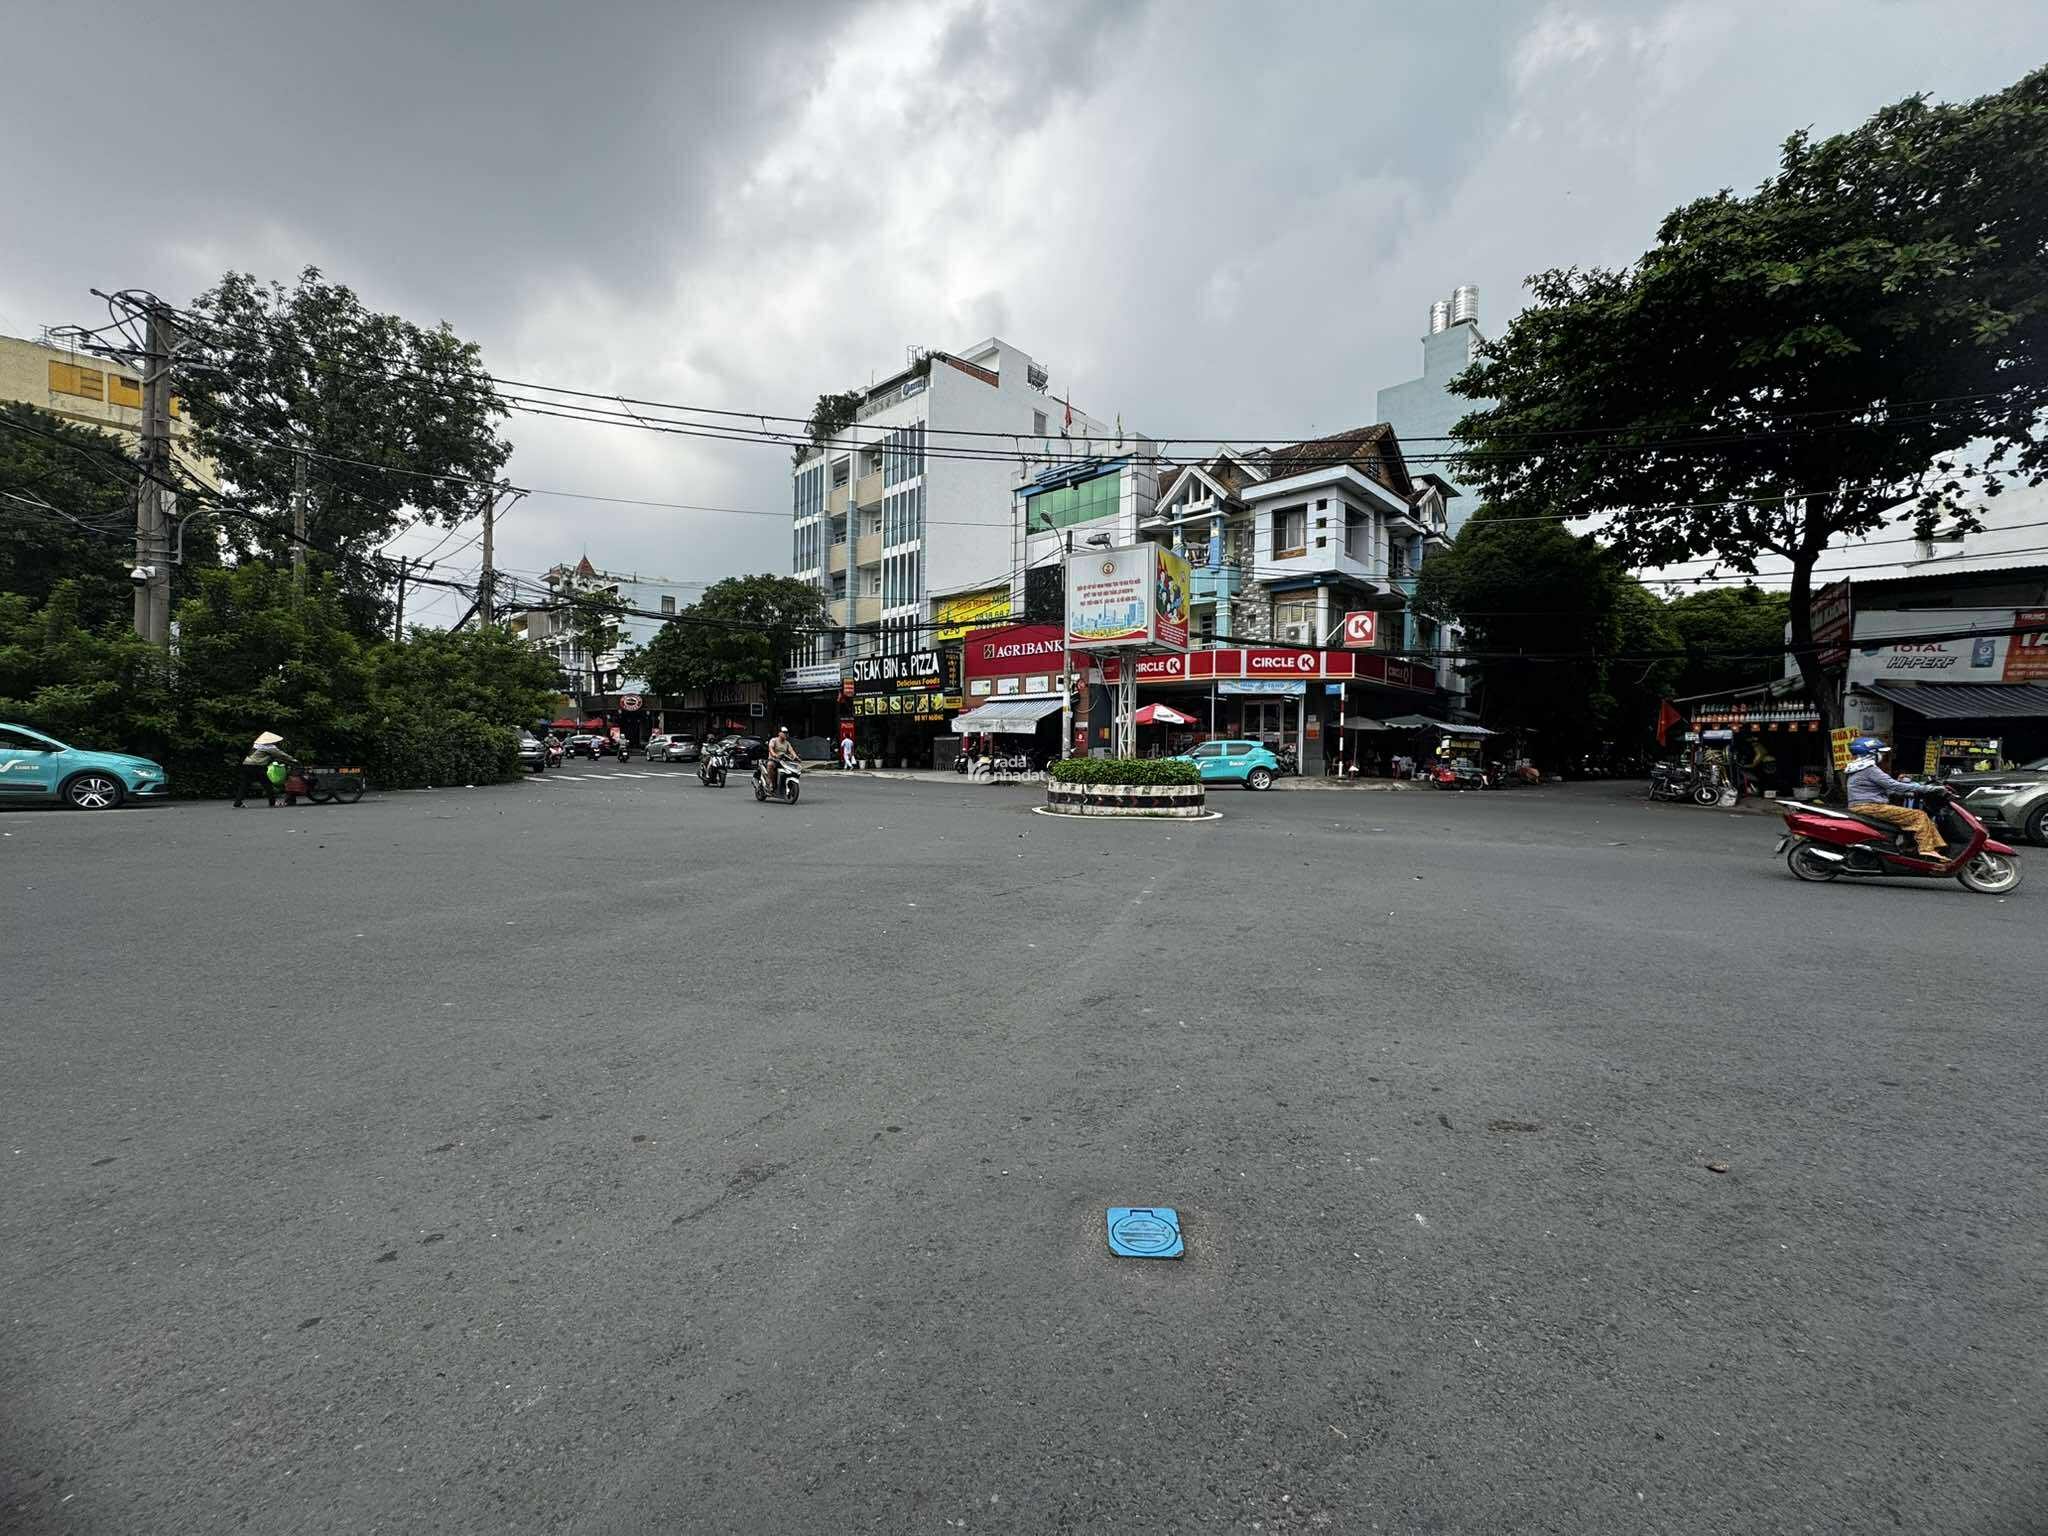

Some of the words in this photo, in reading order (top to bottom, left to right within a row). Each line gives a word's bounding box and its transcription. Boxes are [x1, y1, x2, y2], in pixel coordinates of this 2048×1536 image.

[997, 640, 1064, 657] AGRIBANK
[1893, 643, 1949, 653] TOTAL
[854, 658, 882, 682] STEAK
[883, 657, 899, 680] BIN
[901, 661, 909, 677] &
[911, 652, 939, 676] PIZZA
[1252, 656, 1295, 669] CIRCLE
[1300, 655, 1315, 671] K
[896, 679, 922, 688] Delicious
